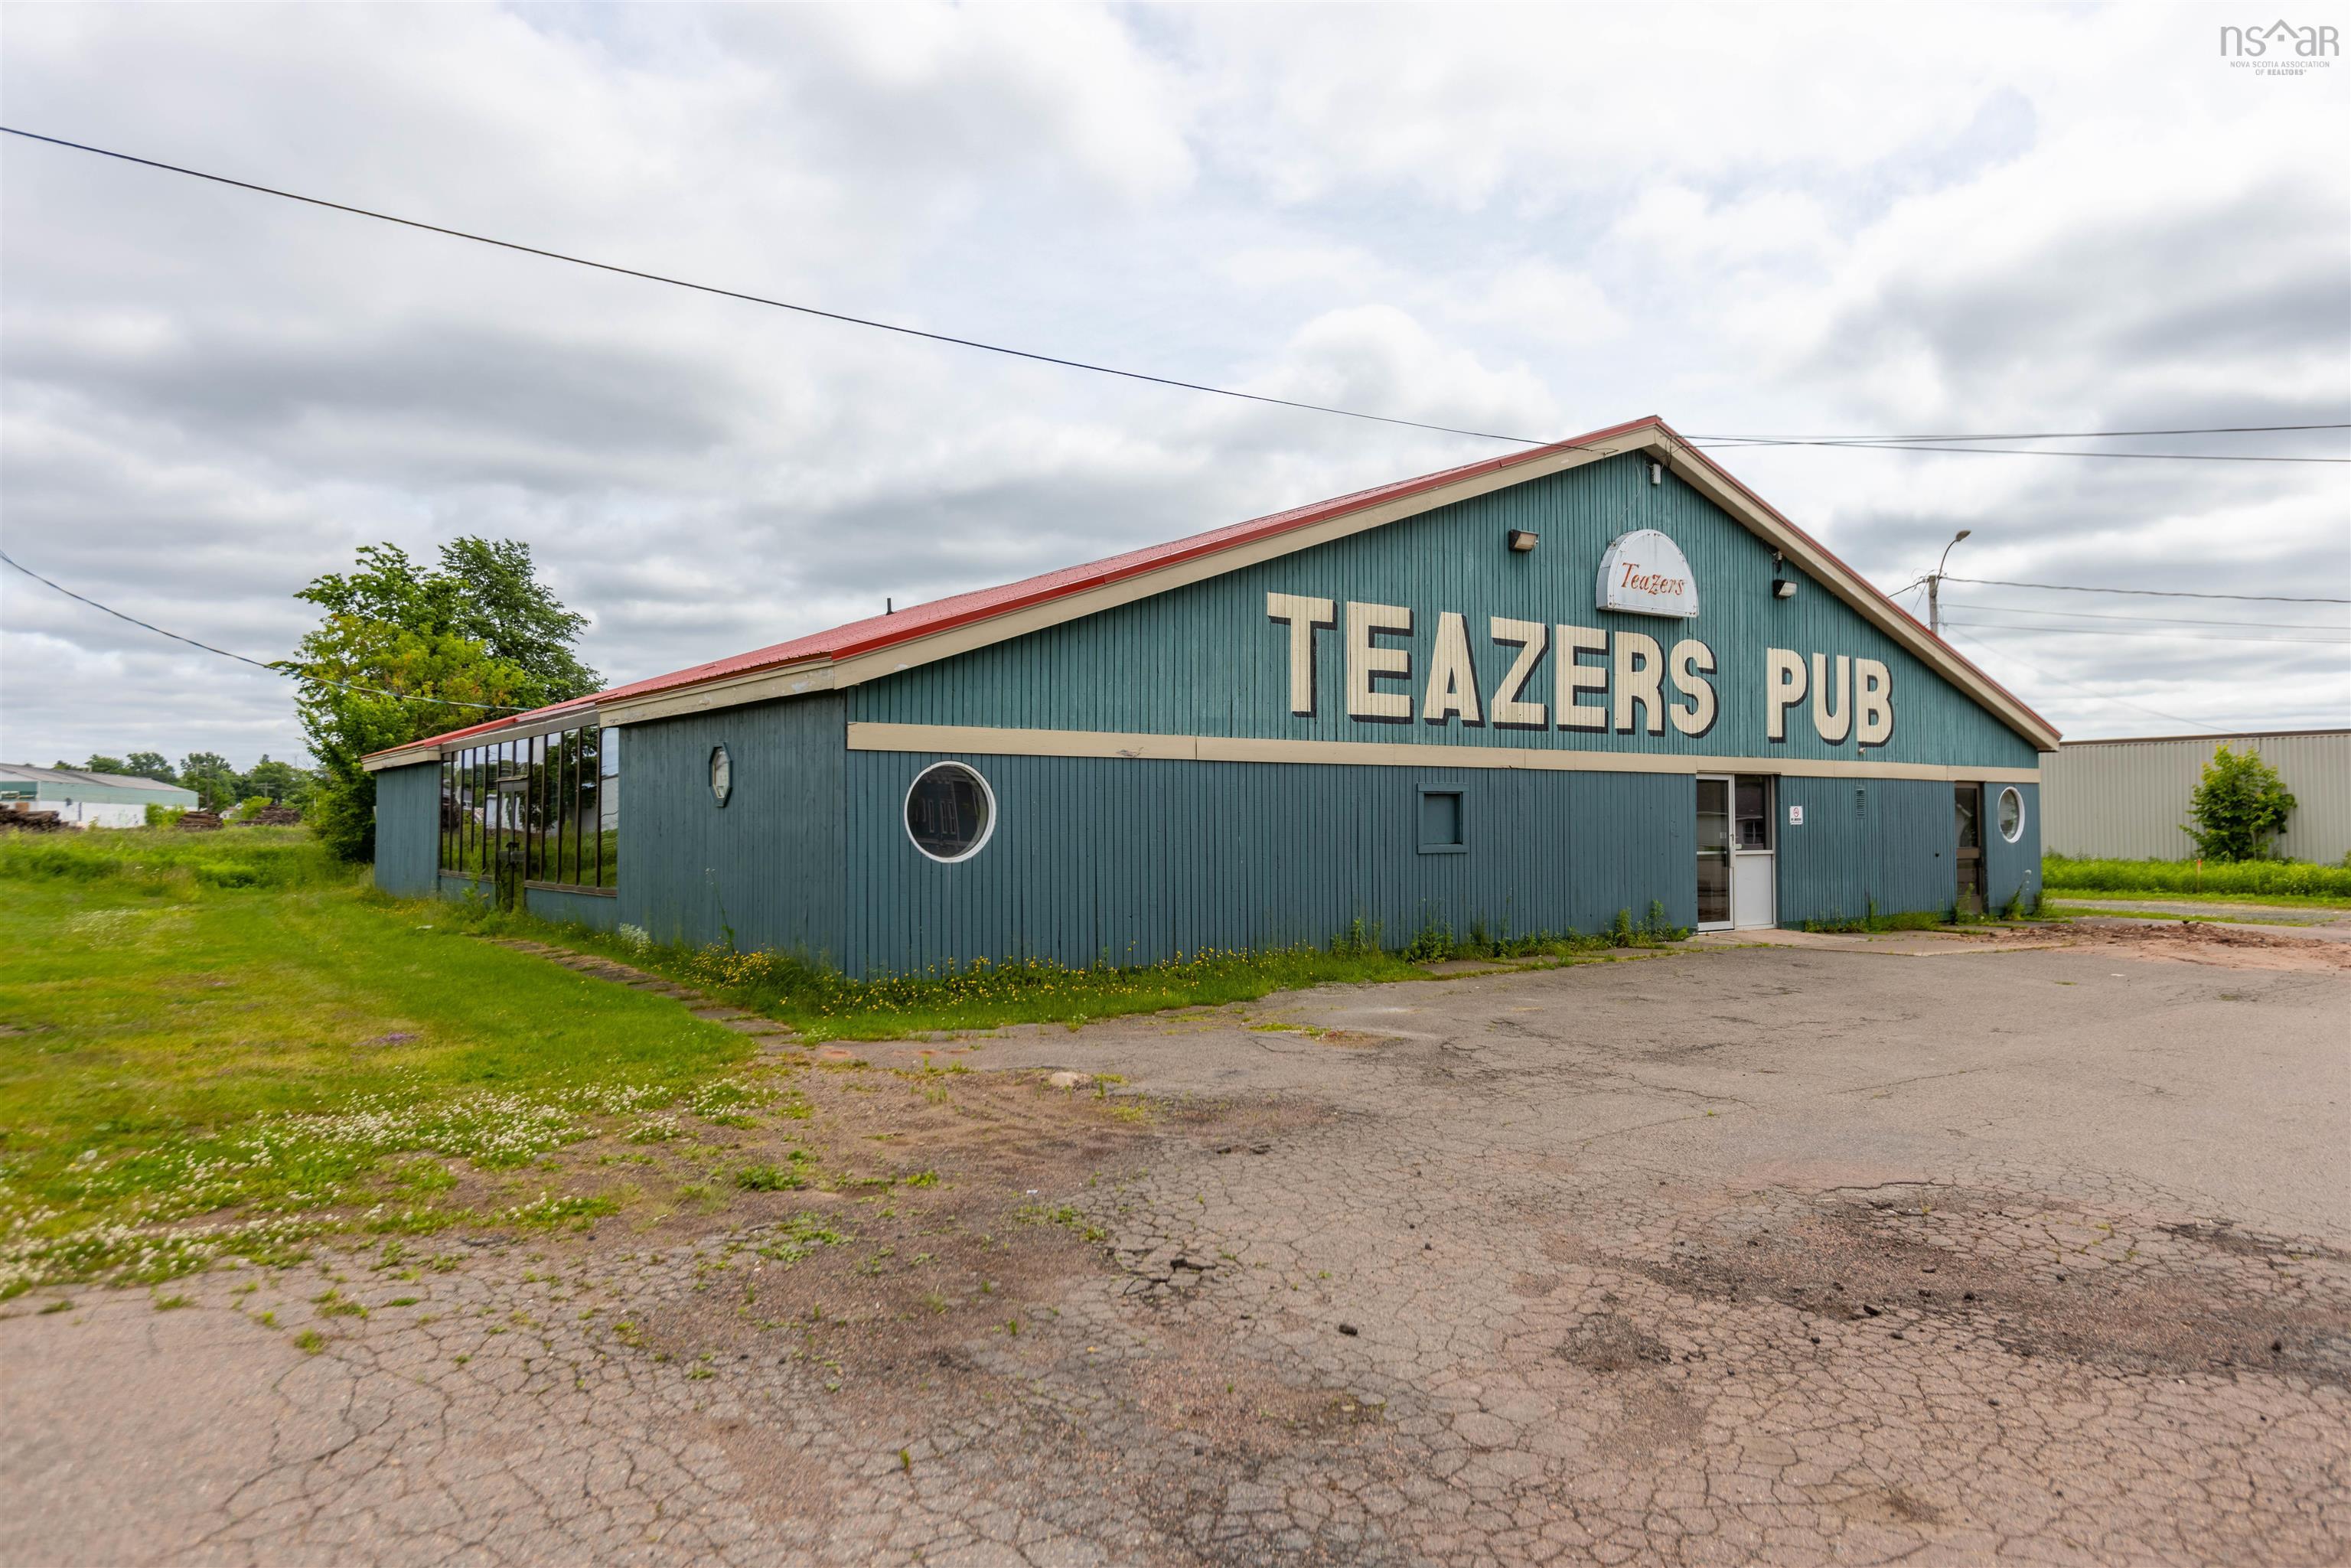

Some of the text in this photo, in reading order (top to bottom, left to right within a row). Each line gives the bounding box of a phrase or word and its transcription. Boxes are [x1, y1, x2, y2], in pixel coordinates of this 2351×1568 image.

[1620, 562, 1687, 596] Teazers
[1267, 592, 1895, 748] TEAZERS PUB
